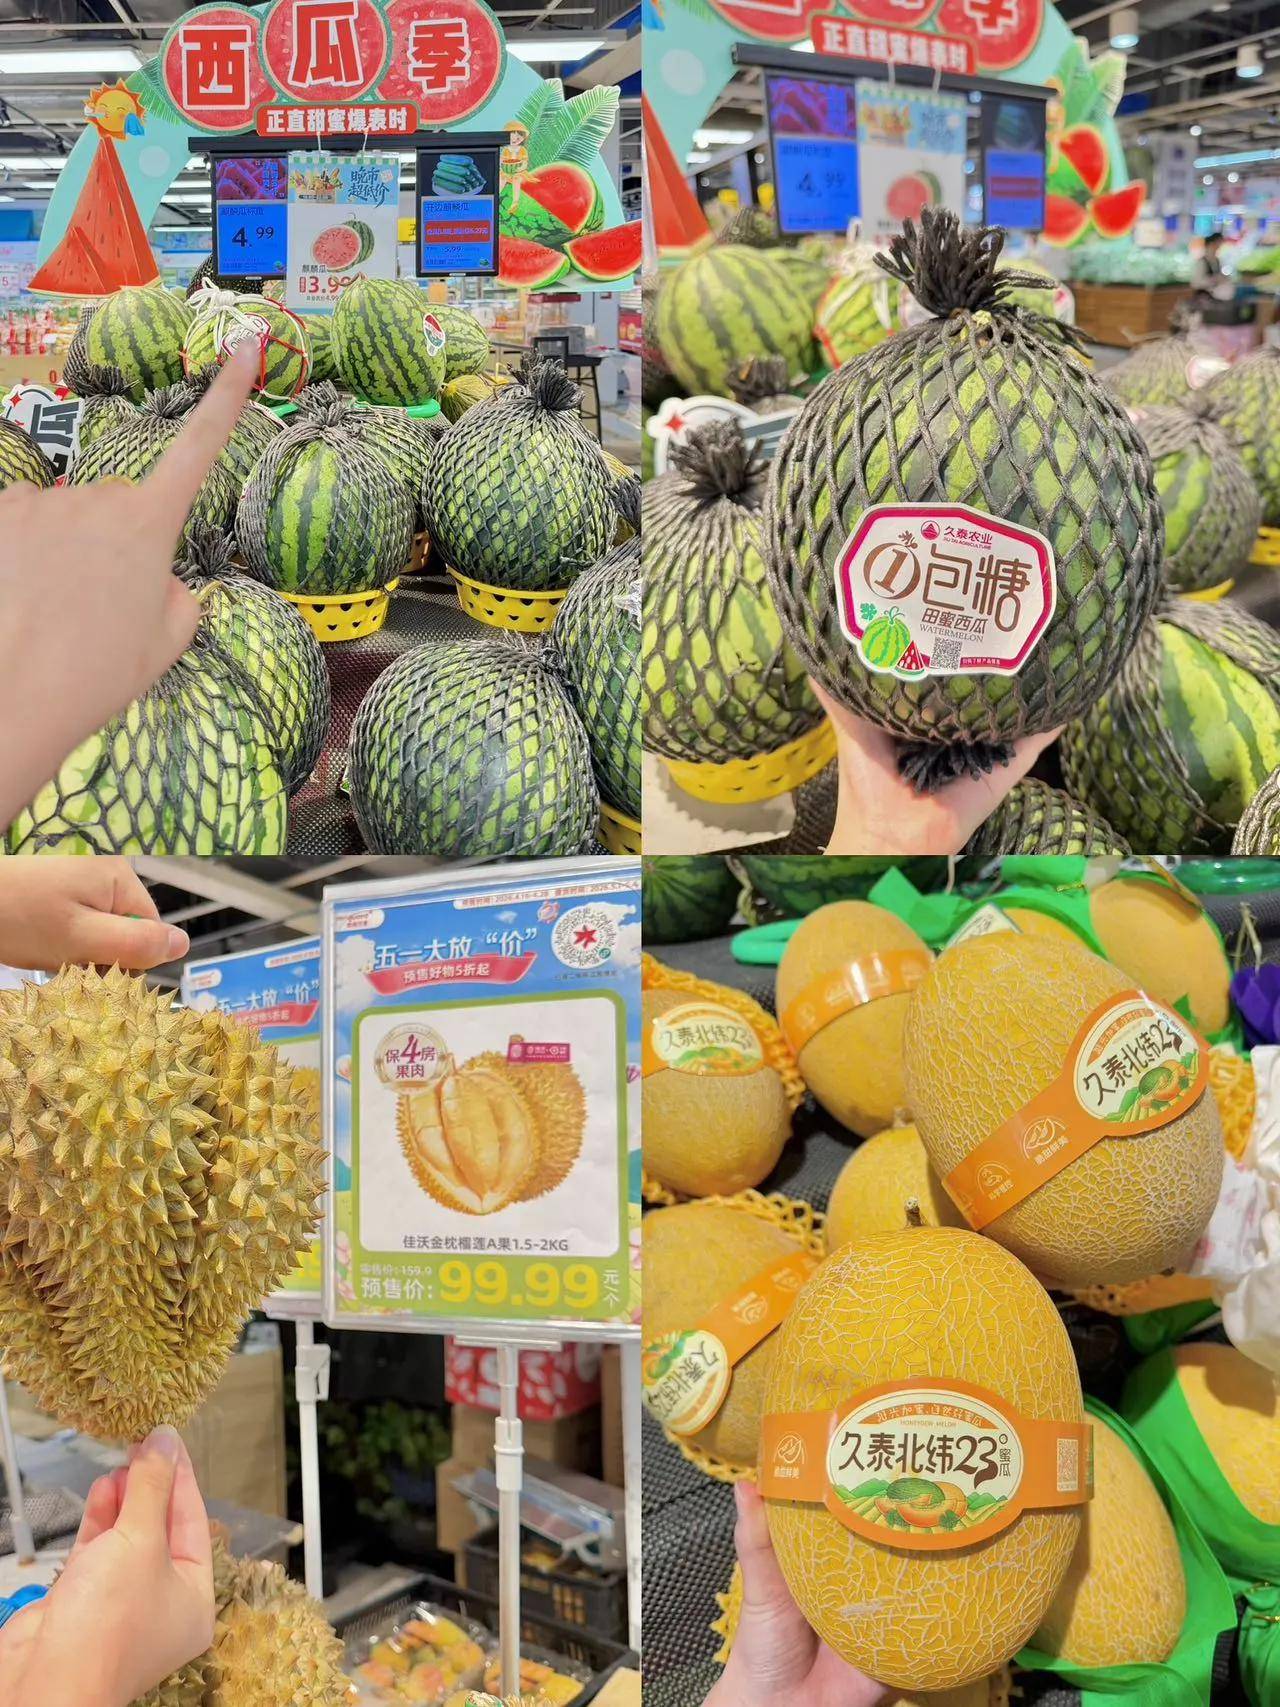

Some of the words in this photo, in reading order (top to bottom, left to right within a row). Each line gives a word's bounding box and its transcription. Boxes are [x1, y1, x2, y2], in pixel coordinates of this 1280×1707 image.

[180, 0, 471, 110] 西瓜季
[266, 109, 408, 133] 正直甜蜜爆表时
[350, 166, 380, 185] 晚市
[348, 183, 390, 208] 超低价
[231, 226, 275, 248] 4.99
[943, 525, 993, 545] 久泰农业
[922, 607, 988, 634] 田蜜西瓜
[920, 624, 984, 643] WATERMELON
[375, 935, 473, 970] 五一大放
[403, 963, 490, 984] 预售好物5折起
[385, 1034, 436, 1064] 保4房
[396, 1064, 425, 1079] 果肉
[361, 1277, 433, 1300] 预售价:
[438, 1260, 598, 1309] 99.99
[998, 1448, 1011, 1477] 蜜瓜
